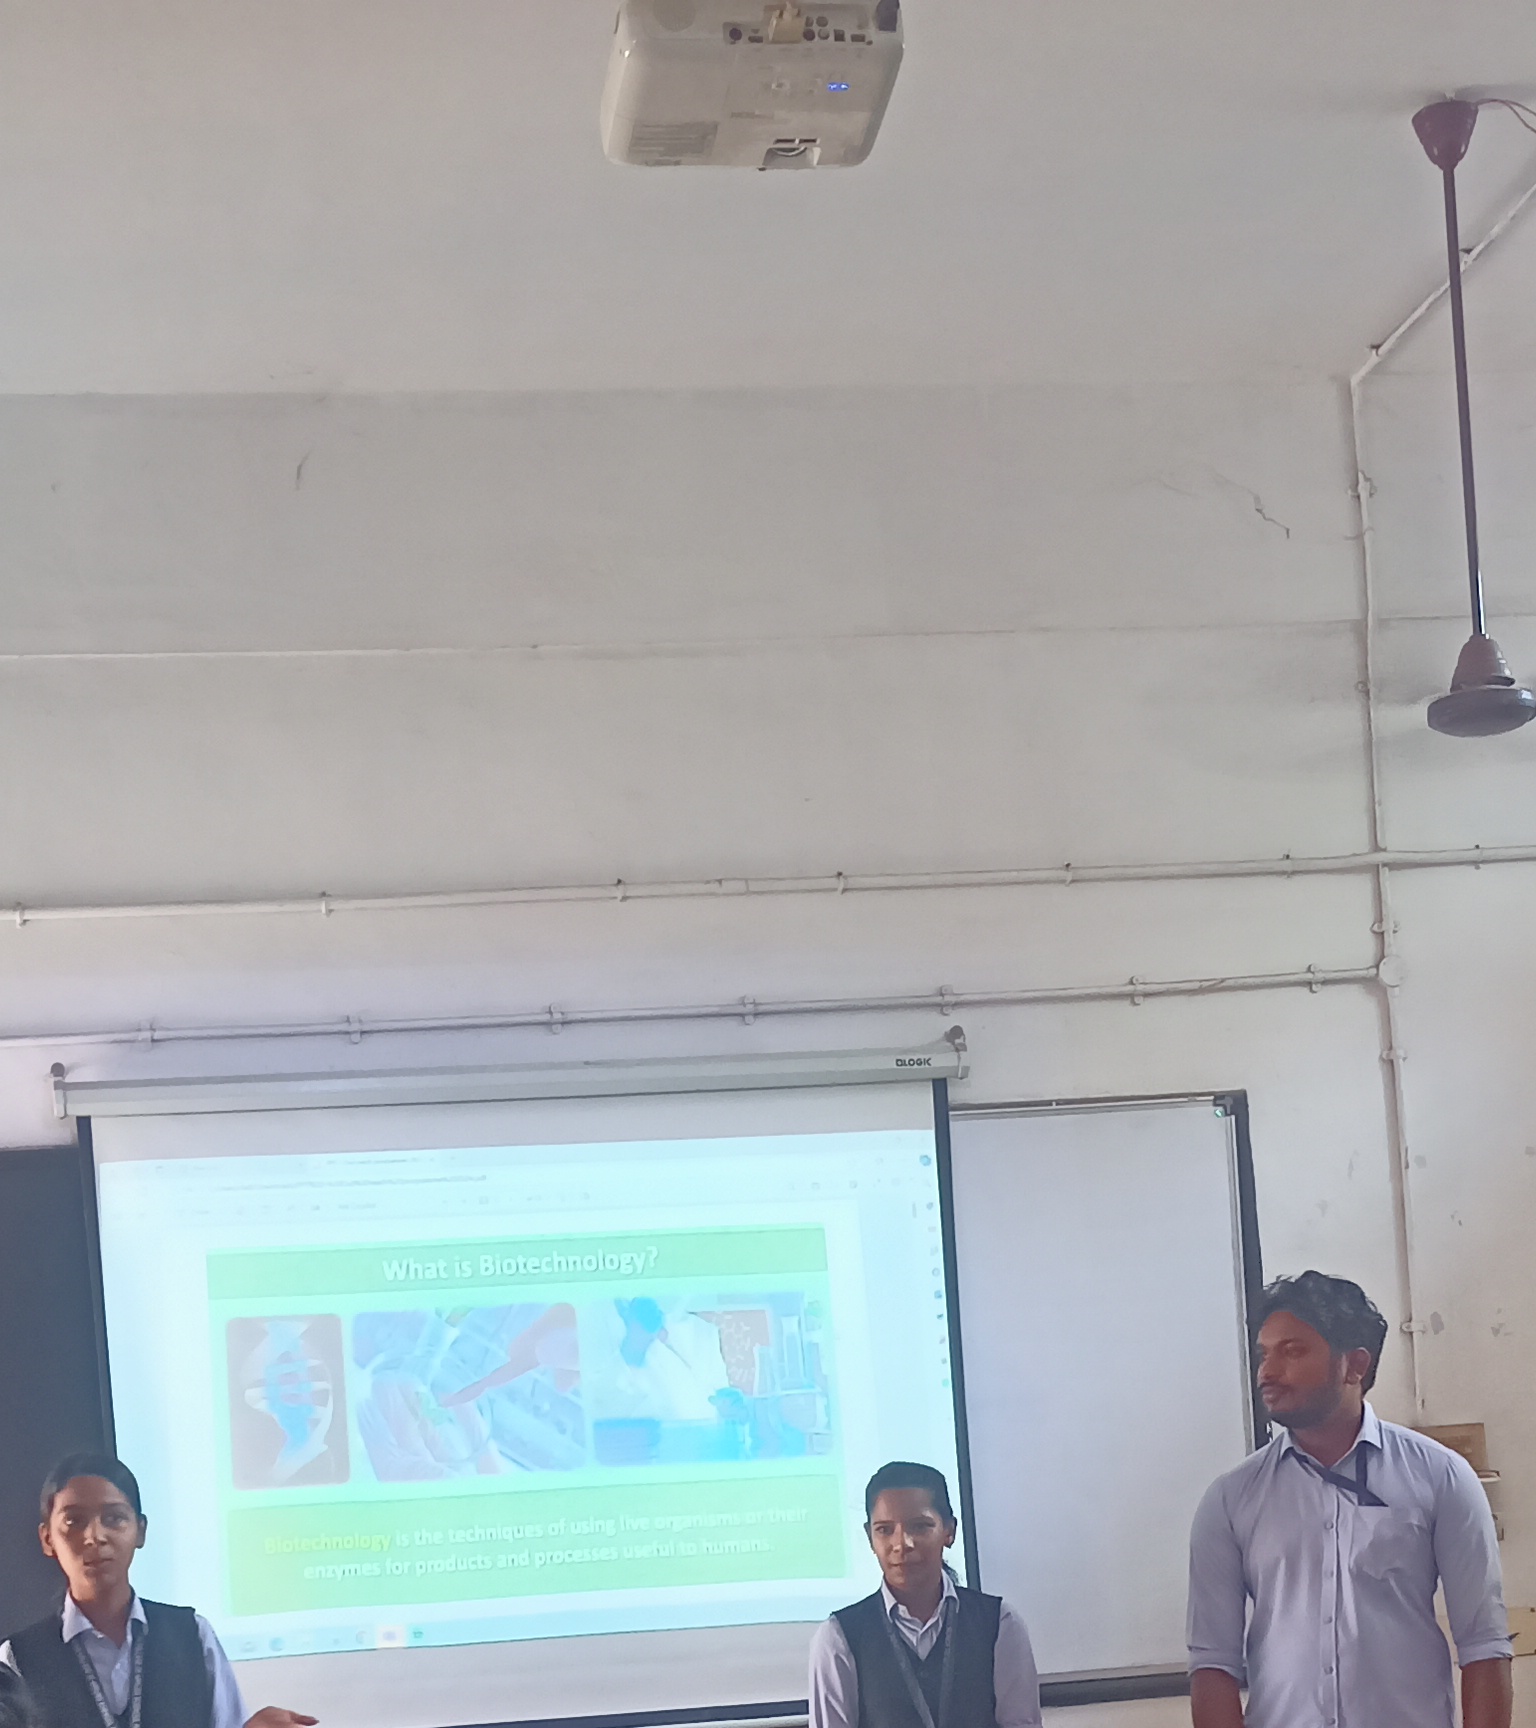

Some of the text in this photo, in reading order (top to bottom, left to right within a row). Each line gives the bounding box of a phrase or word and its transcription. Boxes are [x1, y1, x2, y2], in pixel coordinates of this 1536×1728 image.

[382, 1245, 659, 1282] What is Biotechnology?
[264, 1532, 392, 1555] Biotechnology
[395, 1530, 410, 1548] is
[414, 1527, 444, 1547] the
[448, 1522, 544, 1545] techniques
[547, 1517, 567, 1536] of
[570, 1515, 616, 1537] using
[619, 1514, 650, 1532] live
[654, 1511, 741, 1533] organisms
[767, 1507, 808, 1523] their
[303, 1560, 381, 1582] enzymes
[385, 1557, 412, 1577] for
[415, 1554, 493, 1577] products
[496, 1548, 530, 1569] and
[534, 1544, 618, 1569] processes
[623, 1540, 675, 1560] useful
[680, 1538, 698, 1556] to
